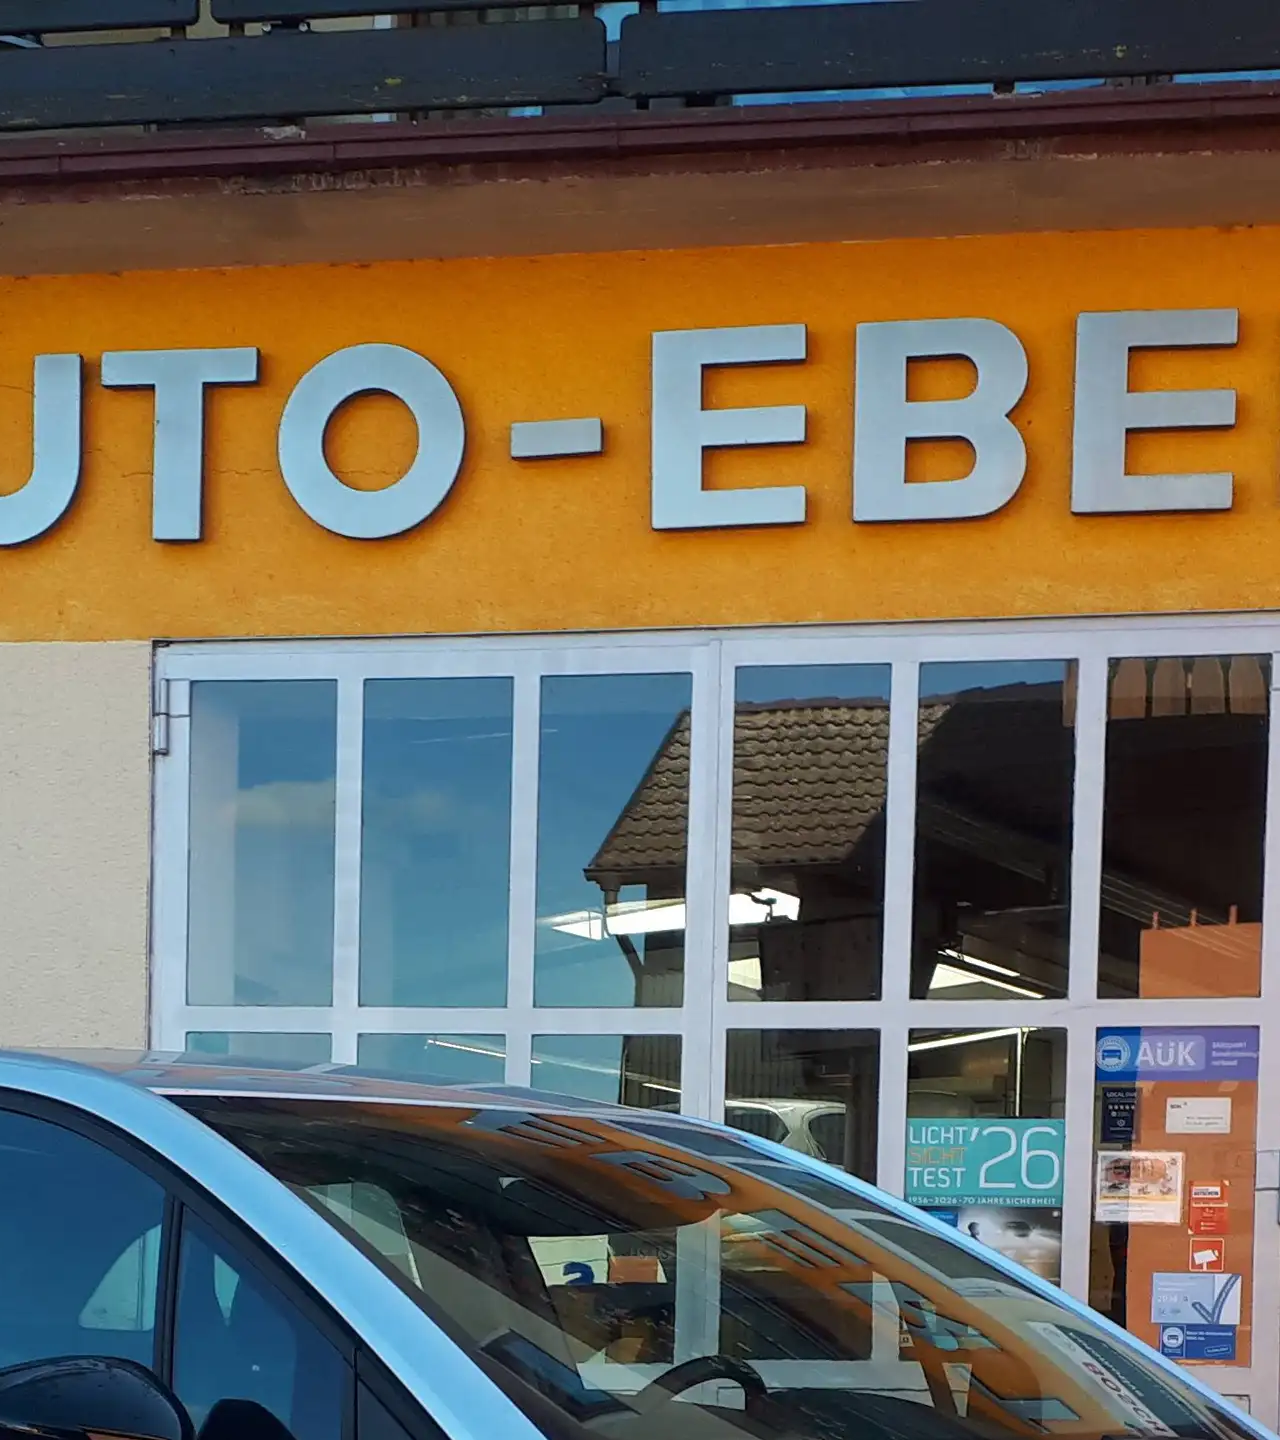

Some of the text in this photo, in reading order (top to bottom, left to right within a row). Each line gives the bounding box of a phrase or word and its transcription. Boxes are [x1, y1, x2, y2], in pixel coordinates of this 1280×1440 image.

[909, 1126, 968, 1145] LICHT
[909, 1146, 968, 1165] SICHT
[908, 1167, 967, 1188] TEST
[977, 1197, 1004, 1205] JAHRE
[1006, 1197, 1056, 1205] SICHERHEIT
